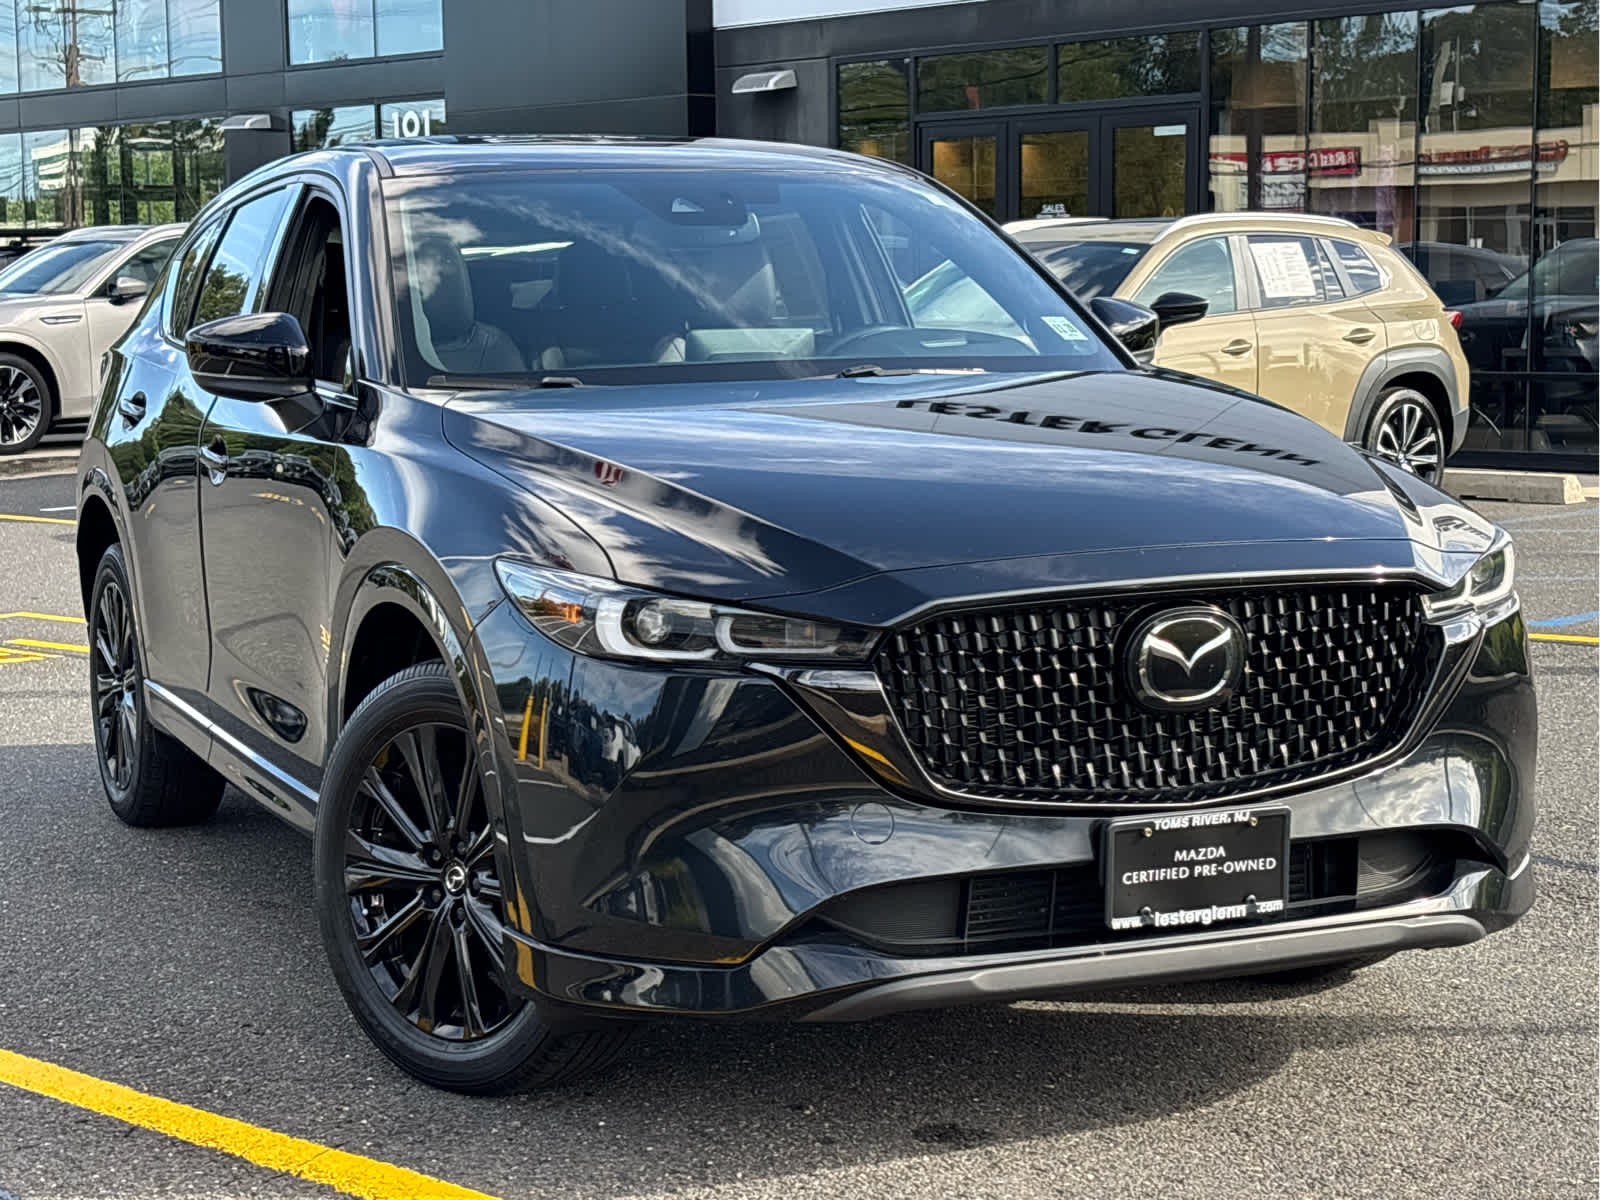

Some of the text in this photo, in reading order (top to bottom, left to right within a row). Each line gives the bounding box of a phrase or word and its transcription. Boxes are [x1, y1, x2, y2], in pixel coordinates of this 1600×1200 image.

[392, 110, 430, 138] 101
[1041, 203, 1065, 214] SALES
[1153, 816, 1189, 831] TOMS
[1233, 809, 1250, 823] NJ
[1174, 846, 1226, 862] MAZDA
[1122, 857, 1277, 885] CERTIFIED PRE-OWNED
